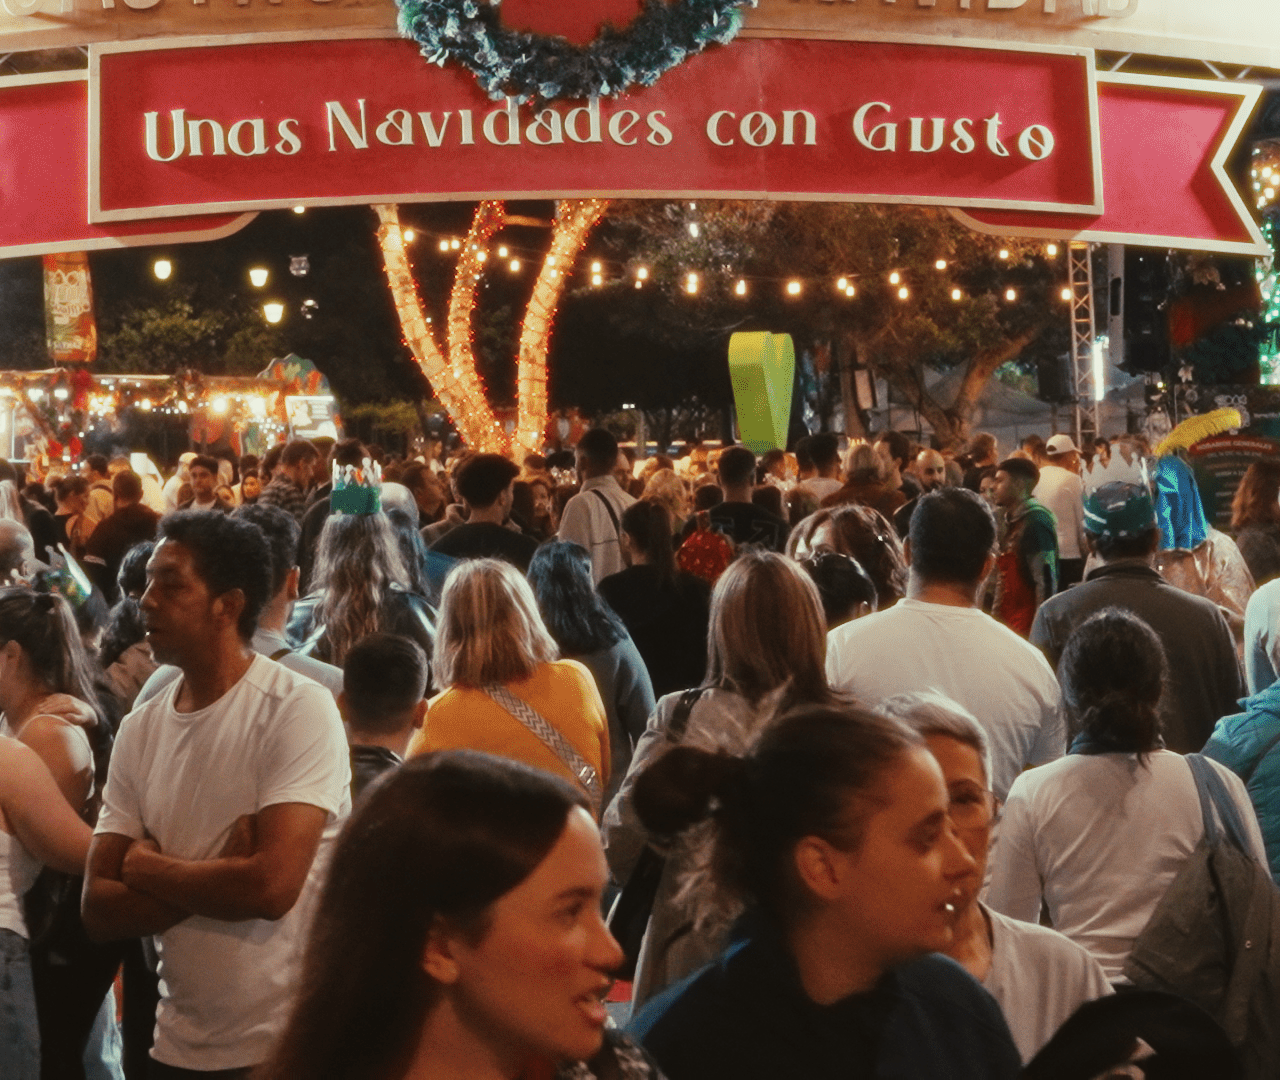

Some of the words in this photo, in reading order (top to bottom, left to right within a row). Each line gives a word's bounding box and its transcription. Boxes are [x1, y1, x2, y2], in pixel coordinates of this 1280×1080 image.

[143, 107, 303, 163] Unas
[324, 94, 674, 153] Navidades
[705, 107, 818, 148] con
[851, 99, 1056, 162] Gusto
